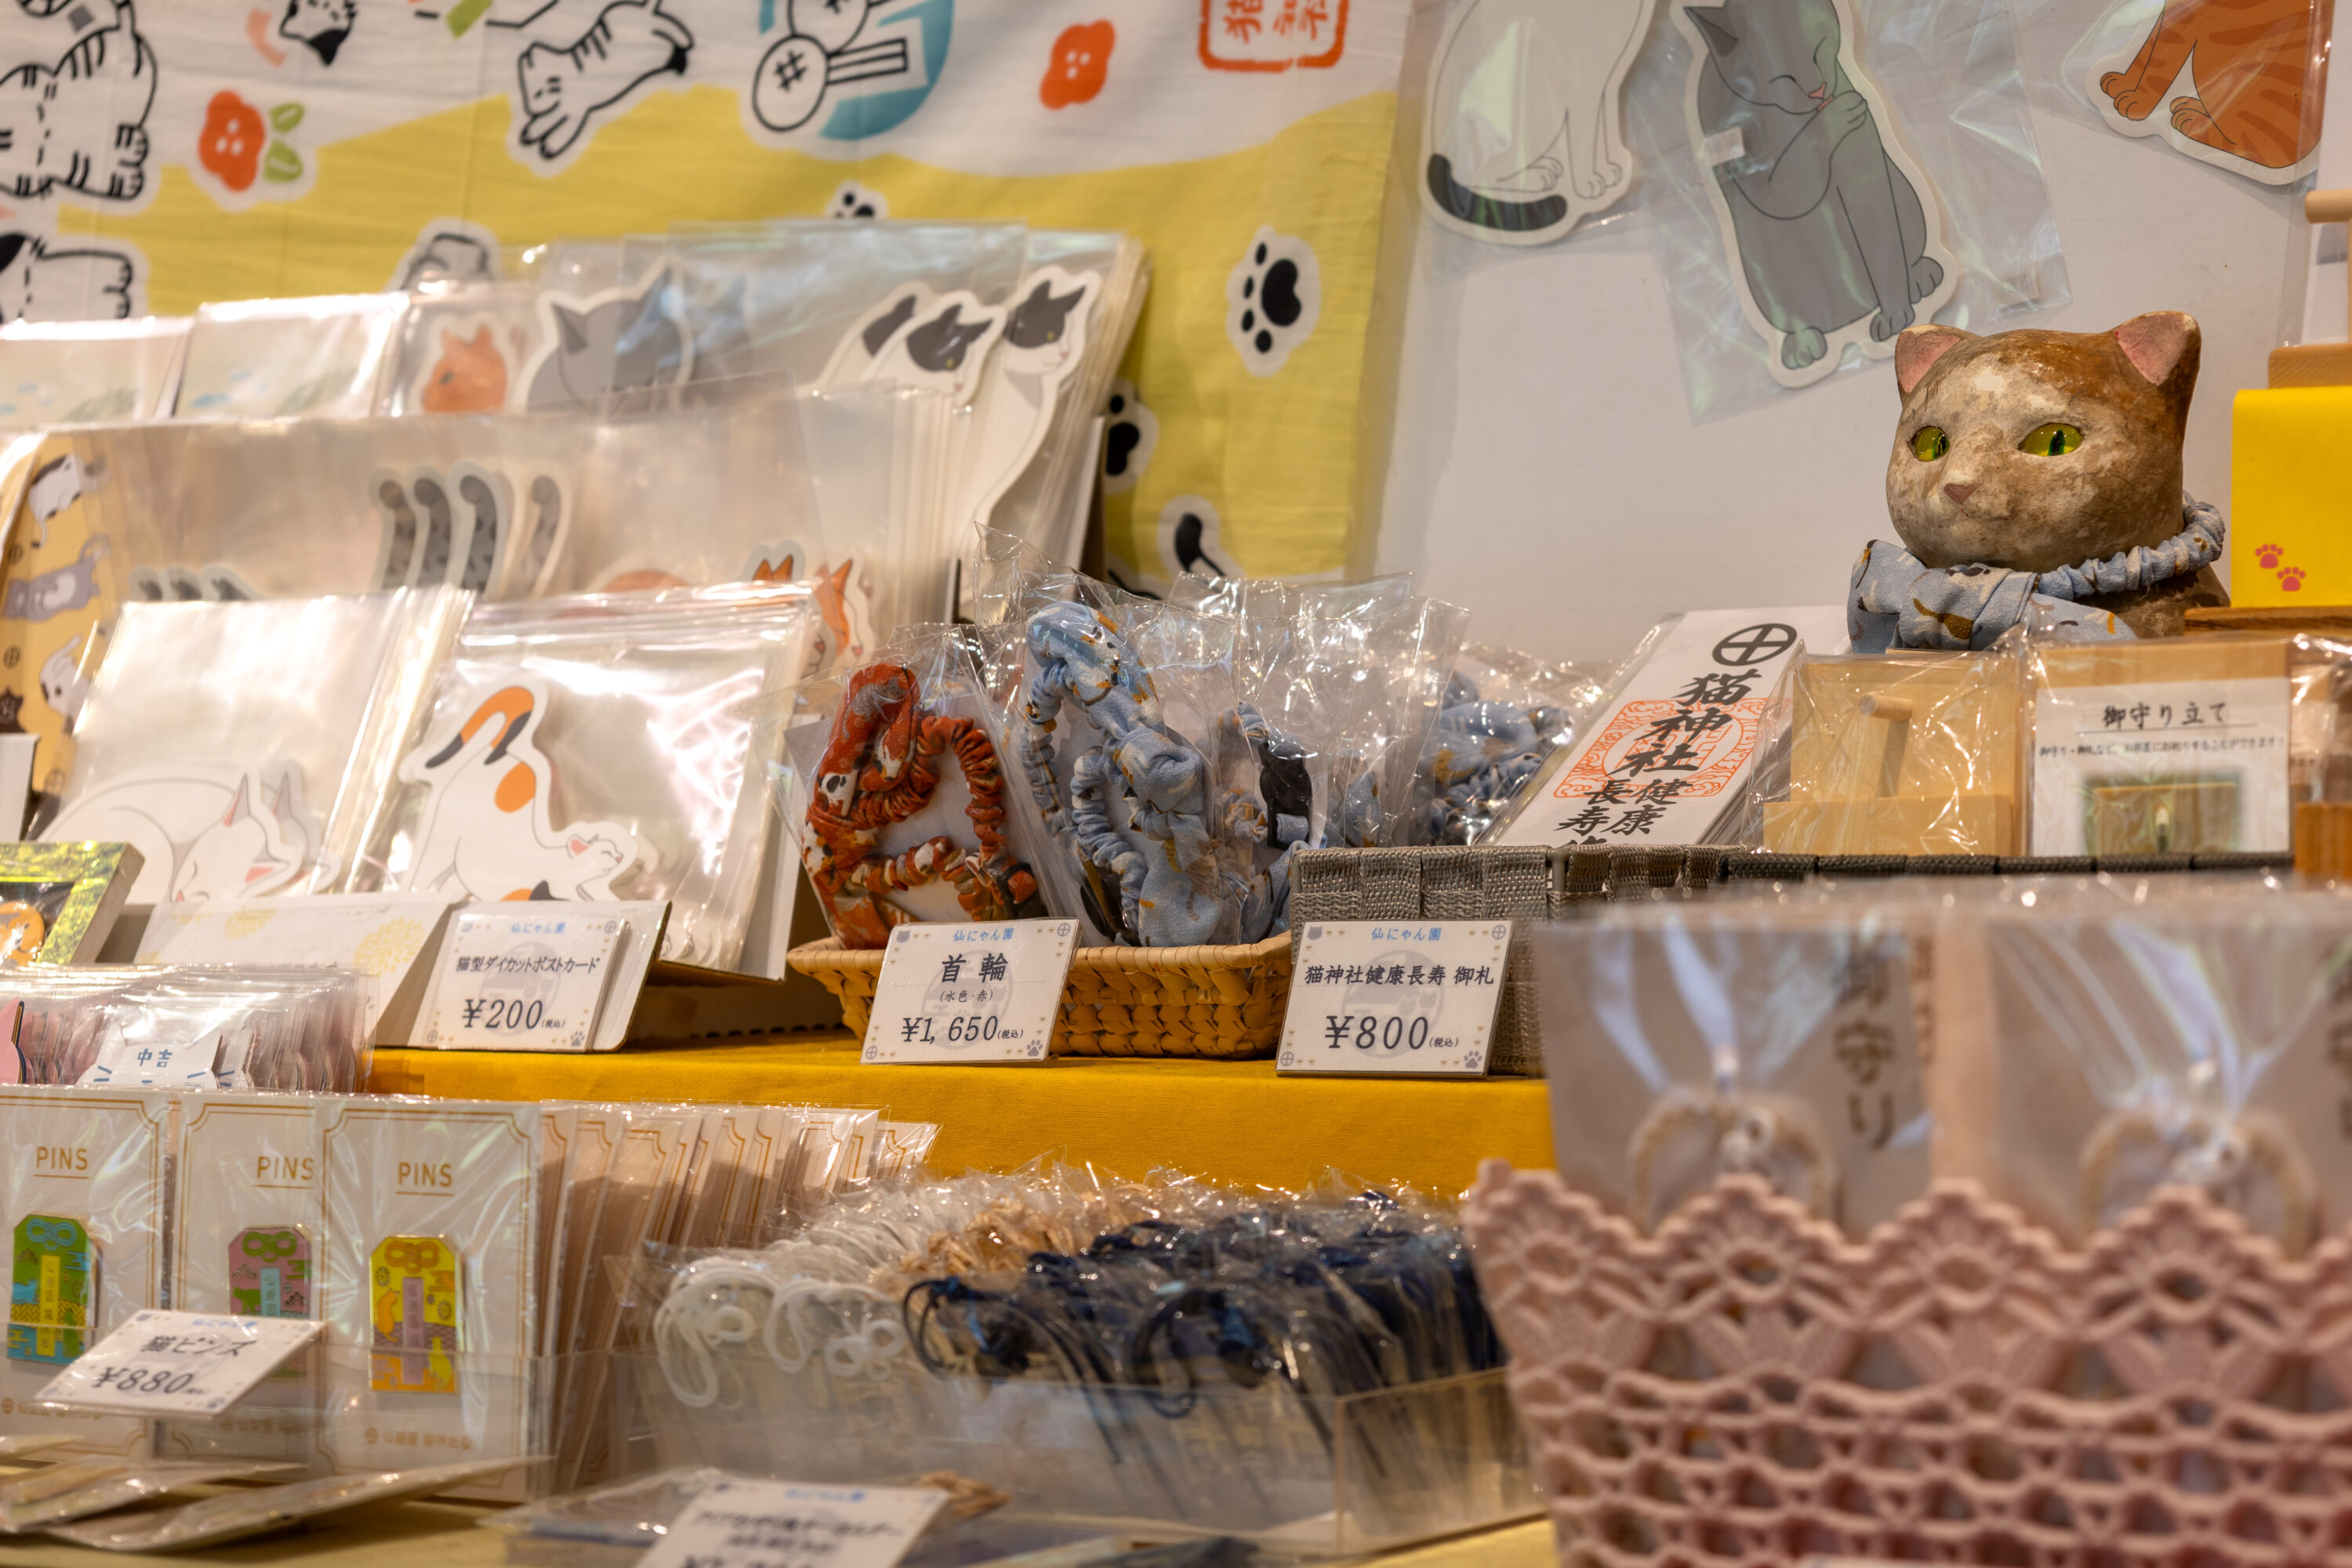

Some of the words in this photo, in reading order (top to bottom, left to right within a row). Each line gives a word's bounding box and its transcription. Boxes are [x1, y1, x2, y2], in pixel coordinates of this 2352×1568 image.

[1606, 669, 1762, 777] 猫神社
[2102, 702, 2226, 729] 御守り立て
[1553, 779, 1634, 845] 長寿
[1599, 778, 1693, 836] 健康
[953, 928, 1014, 942] 仙にゃん園
[1371, 927, 1442, 941] 仙にゃん園
[940, 953, 1008, 983] 首輪
[1304, 964, 1446, 985] 猫神社健康長寿
[1453, 965, 1494, 985] 御札
[137, 1048, 172, 1068] 中吉
[36, 1146, 88, 1171] PINS
[256, 1156, 314, 1181] PINS
[397, 1162, 453, 1187] PINS
